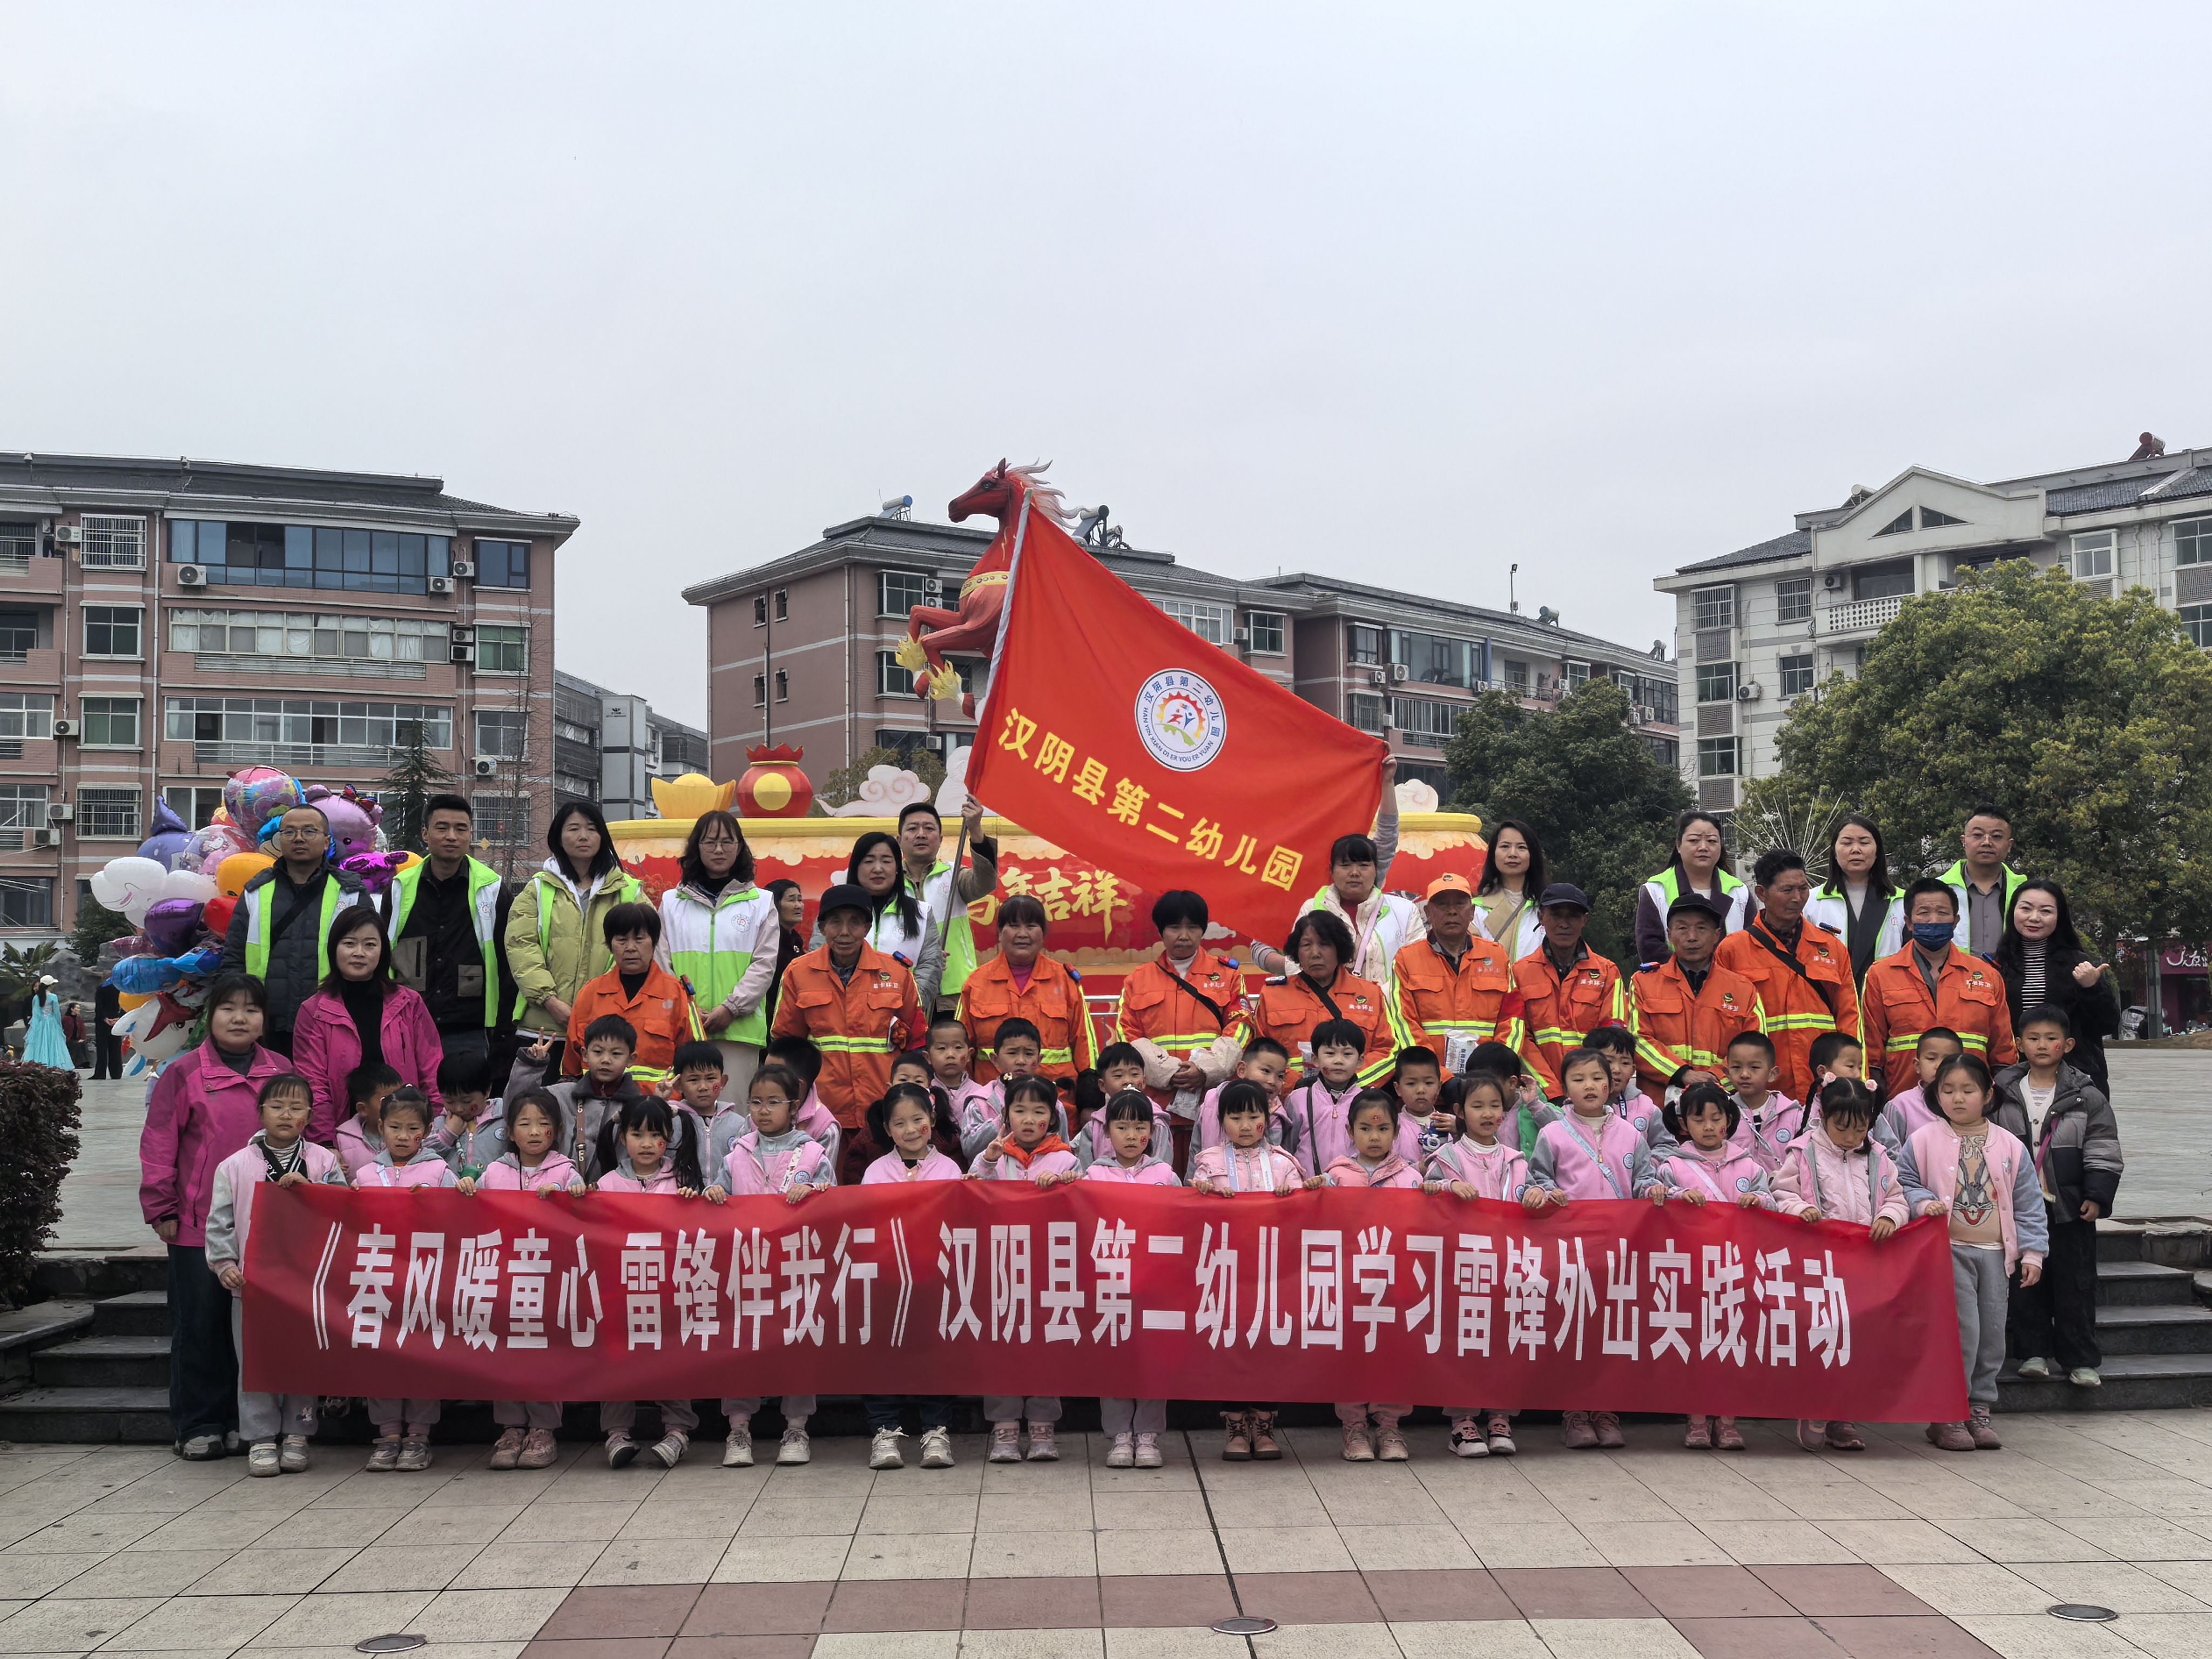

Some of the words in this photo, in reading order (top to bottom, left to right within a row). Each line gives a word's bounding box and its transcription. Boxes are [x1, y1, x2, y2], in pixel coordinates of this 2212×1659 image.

[998, 707, 1303, 891] 汉阴县第二幼儿园
